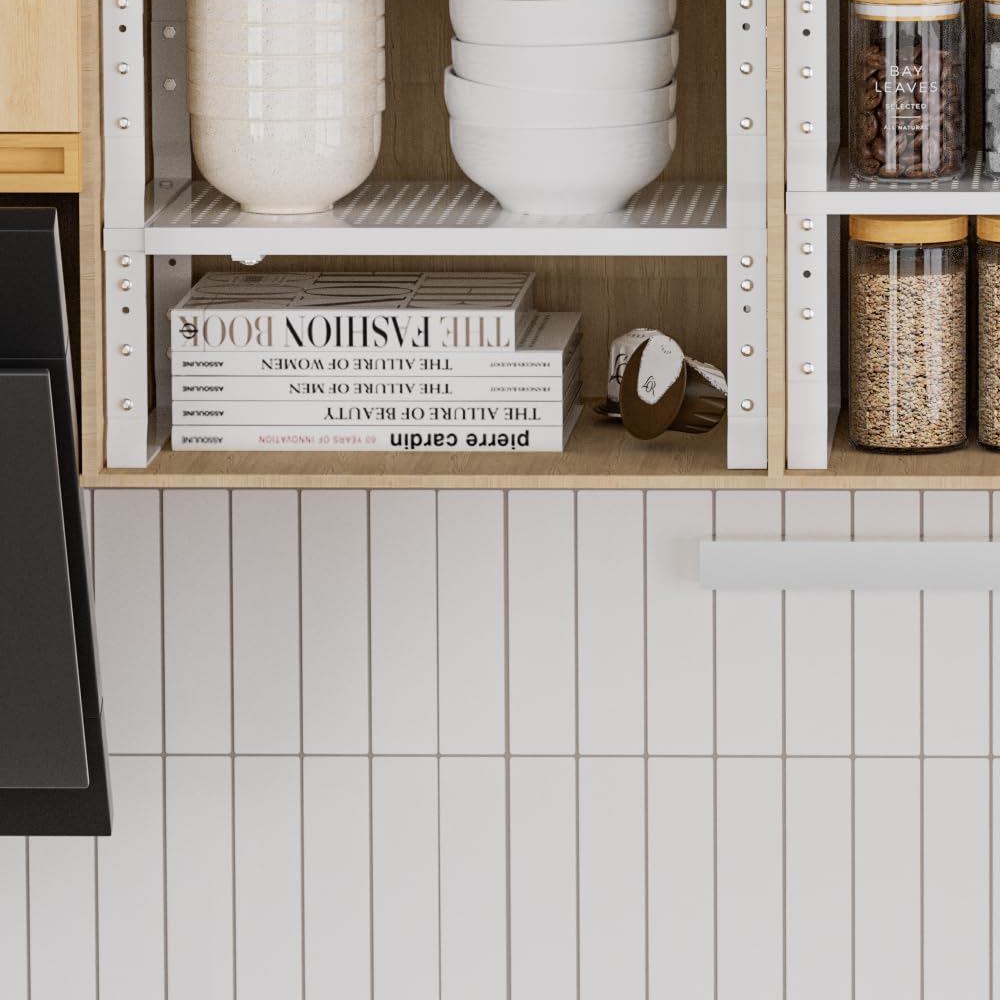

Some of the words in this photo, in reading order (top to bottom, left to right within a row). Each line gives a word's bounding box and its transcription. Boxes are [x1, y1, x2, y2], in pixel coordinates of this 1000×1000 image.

[890, 65, 923, 76] BAY
[875, 81, 938, 93] LEAVES
[178, 315, 273, 347] BOOK
[284, 315, 431, 347] FASHION
[440, 316, 510, 347] THE
[261, 358, 324, 370] WOMEN
[328, 358, 349, 370] OF
[353, 358, 415, 370] ALLURE
[420, 358, 453, 370] THE
[289, 383, 324, 394] MEN
[328, 383, 349, 394] OF
[353, 383, 415, 394] ALLURE
[420, 383, 453, 394] THE
[323, 407, 396, 420] BEAUTY
[401, 407, 425, 420] OF
[429, 407, 499, 420] ALLURE
[504, 407, 541, 420] THE
[181, 436, 223, 444] ASSOULINE
[258, 434, 312, 444] INNOVATION
[318, 434, 330, 444] OF
[333, 434, 362, 444] YEARS
[390, 433, 457, 450] cardin
[466, 430, 529, 450] pierre
